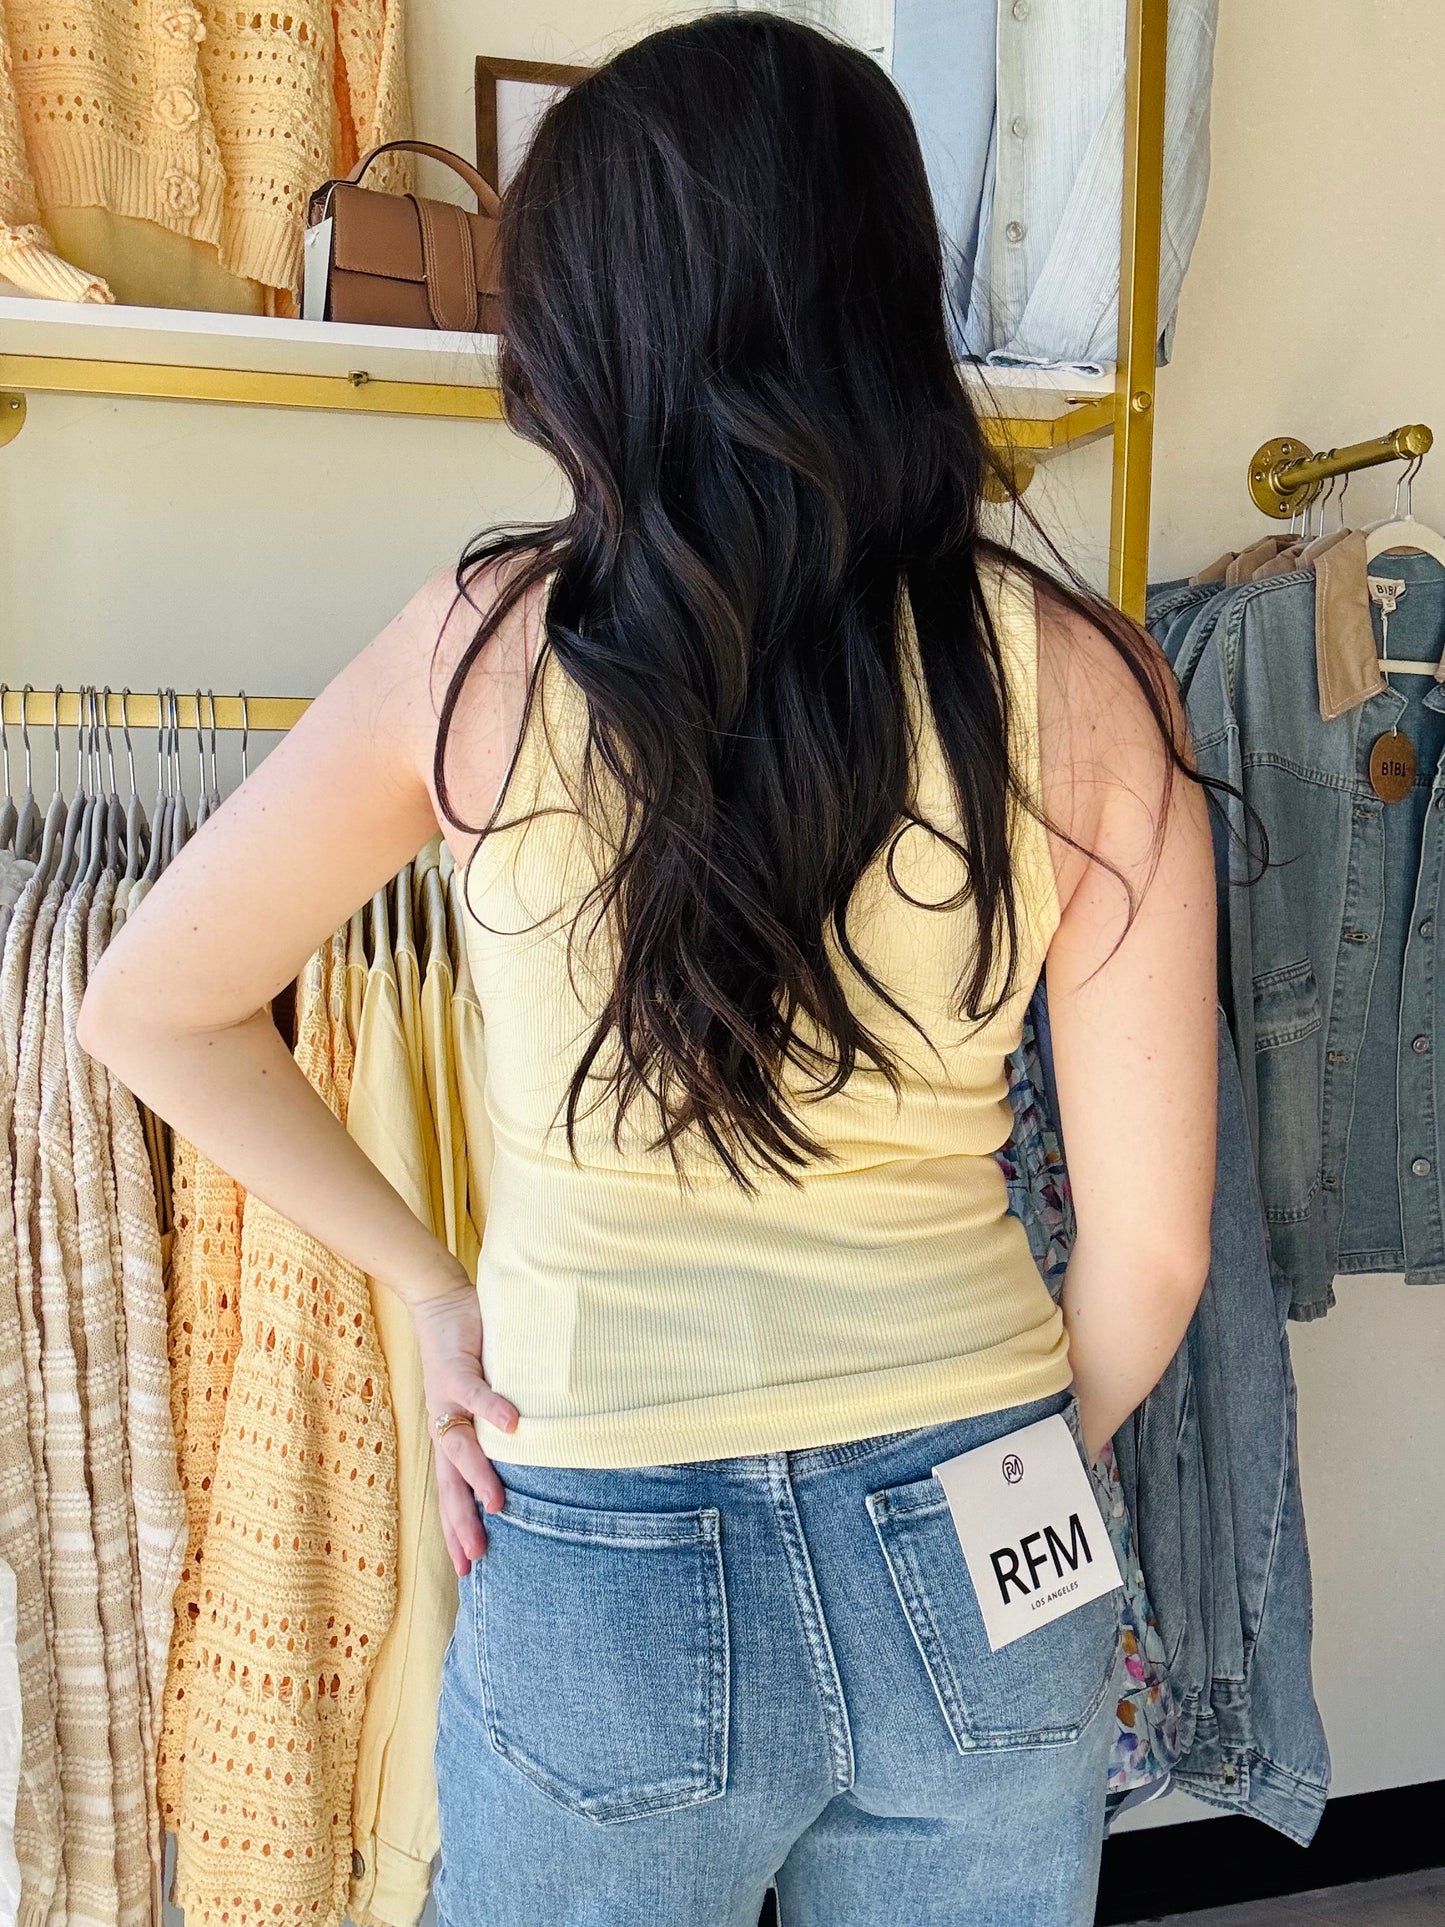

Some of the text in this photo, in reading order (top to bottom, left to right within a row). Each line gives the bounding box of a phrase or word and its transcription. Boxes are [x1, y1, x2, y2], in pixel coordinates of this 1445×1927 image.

[1375, 584, 1397, 597] BIBI
[1381, 761, 1406, 777] BIBI
[990, 1513, 1093, 1605] RFM
[1031, 1581, 1079, 1611] LOS ANGELES
